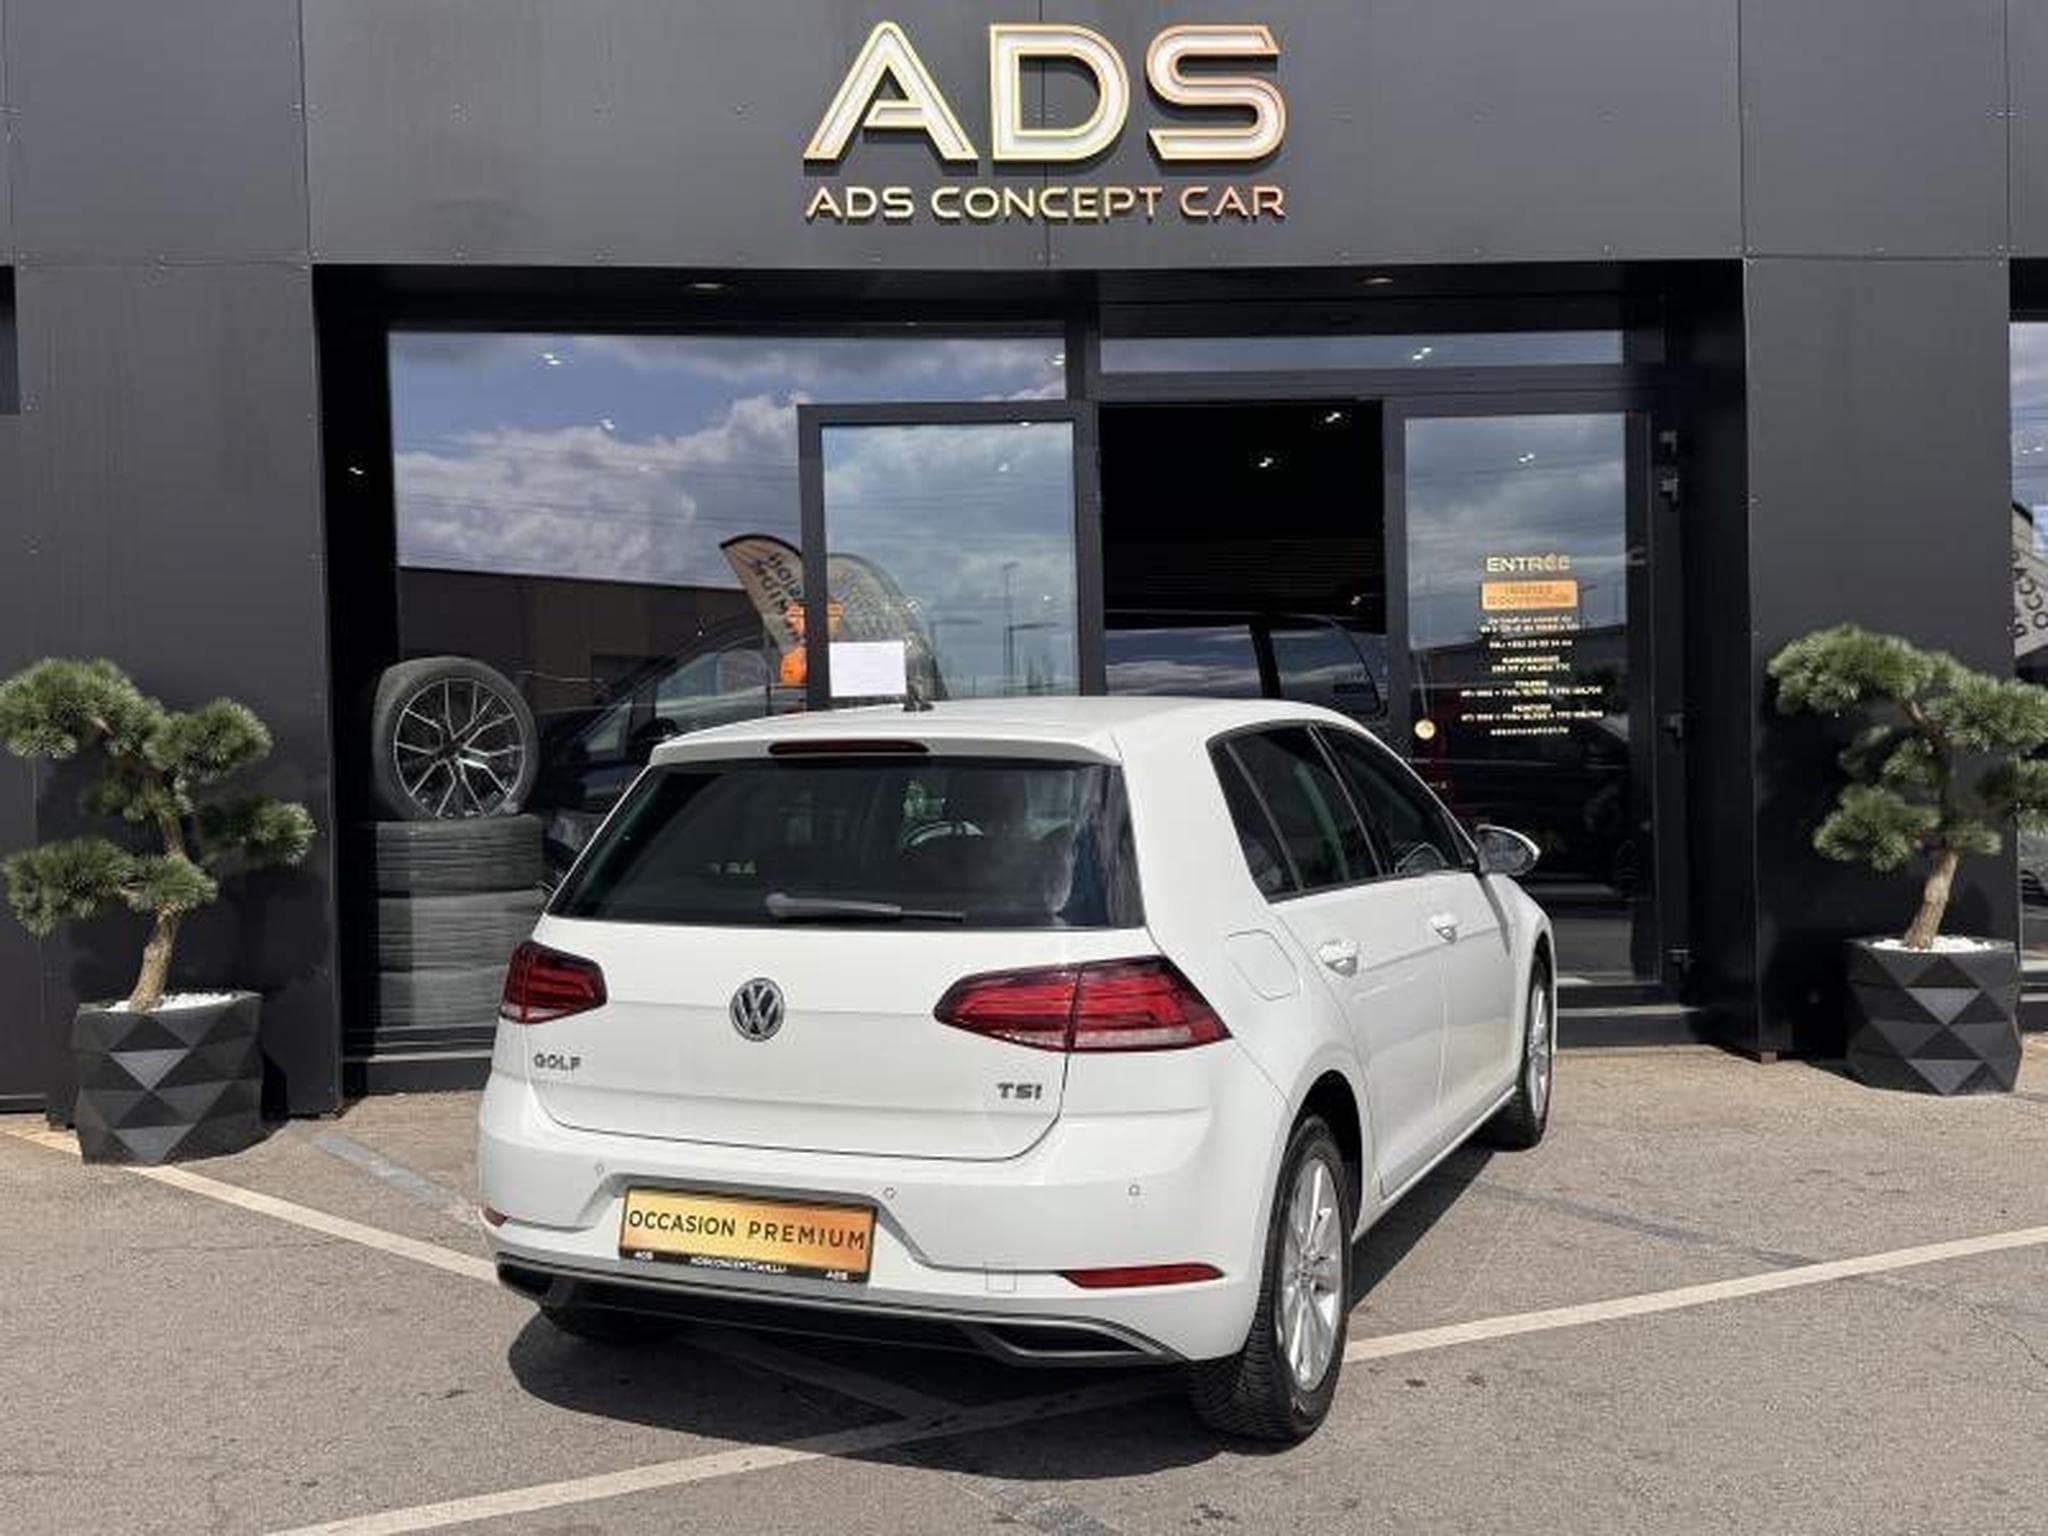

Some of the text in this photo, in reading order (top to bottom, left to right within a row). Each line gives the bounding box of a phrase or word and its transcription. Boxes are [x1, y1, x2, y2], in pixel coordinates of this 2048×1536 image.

[802, 20, 1288, 162] ADS
[805, 186, 1286, 219] ADS CONCEPT CAR
[533, 1053, 582, 1071] GOLF
[997, 1083, 1042, 1100] TSI
[628, 1210, 866, 1250] OCCASION PREMIUM
